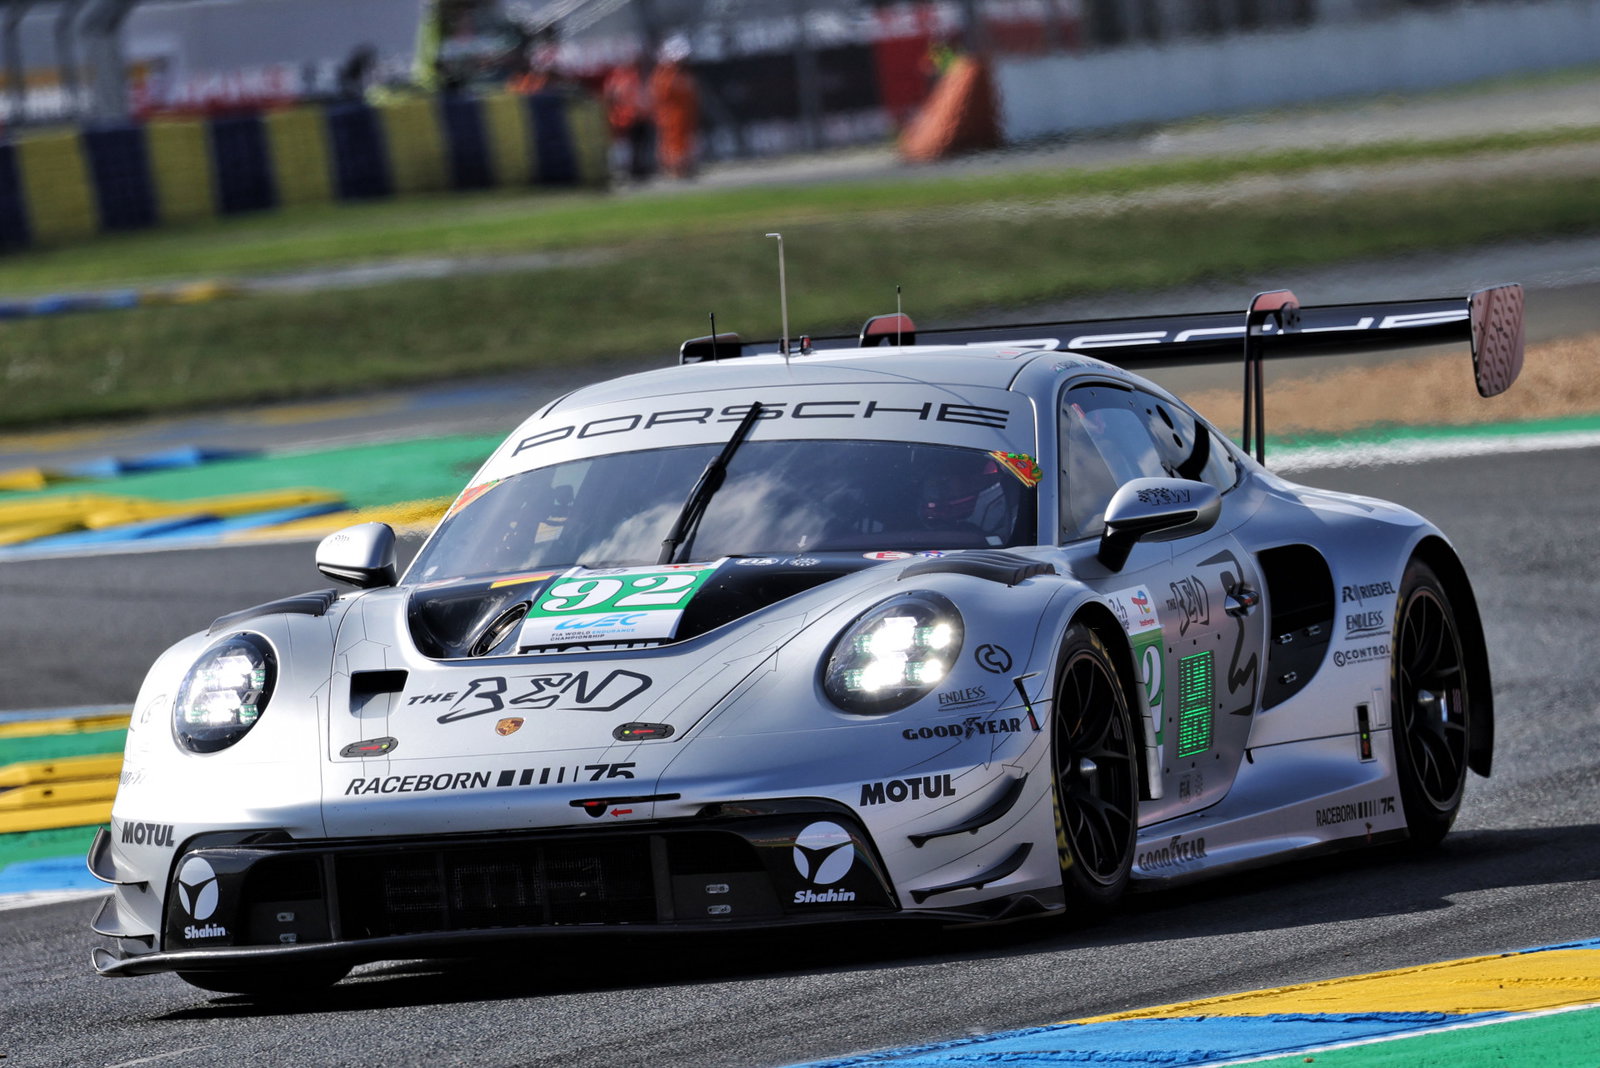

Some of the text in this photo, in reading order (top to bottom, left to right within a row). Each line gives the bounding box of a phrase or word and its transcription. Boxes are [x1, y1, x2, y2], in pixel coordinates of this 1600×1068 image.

[512, 400, 1010, 457] PORSCHE
[541, 573, 697, 612] 92
[1360, 581, 1396, 600] RIEDEL
[554, 613, 648, 630] WEC
[1346, 610, 1384, 630] ENDLESS
[1345, 644, 1391, 660] CONTROL
[408, 669, 652, 724] THE BEND
[938, 685, 986, 704] ENDLESS
[902, 717, 1021, 741] GOODYEAR
[345, 762, 636, 795] RACEBORN 75
[860, 774, 956, 806] MOTUL
[1316, 796, 1396, 827] RACEBORN 75
[121, 821, 175, 847] MOTUL
[1138, 835, 1208, 872] GOODYEAR
[794, 888, 855, 904] Shahin
[184, 923, 226, 939] Shahin
